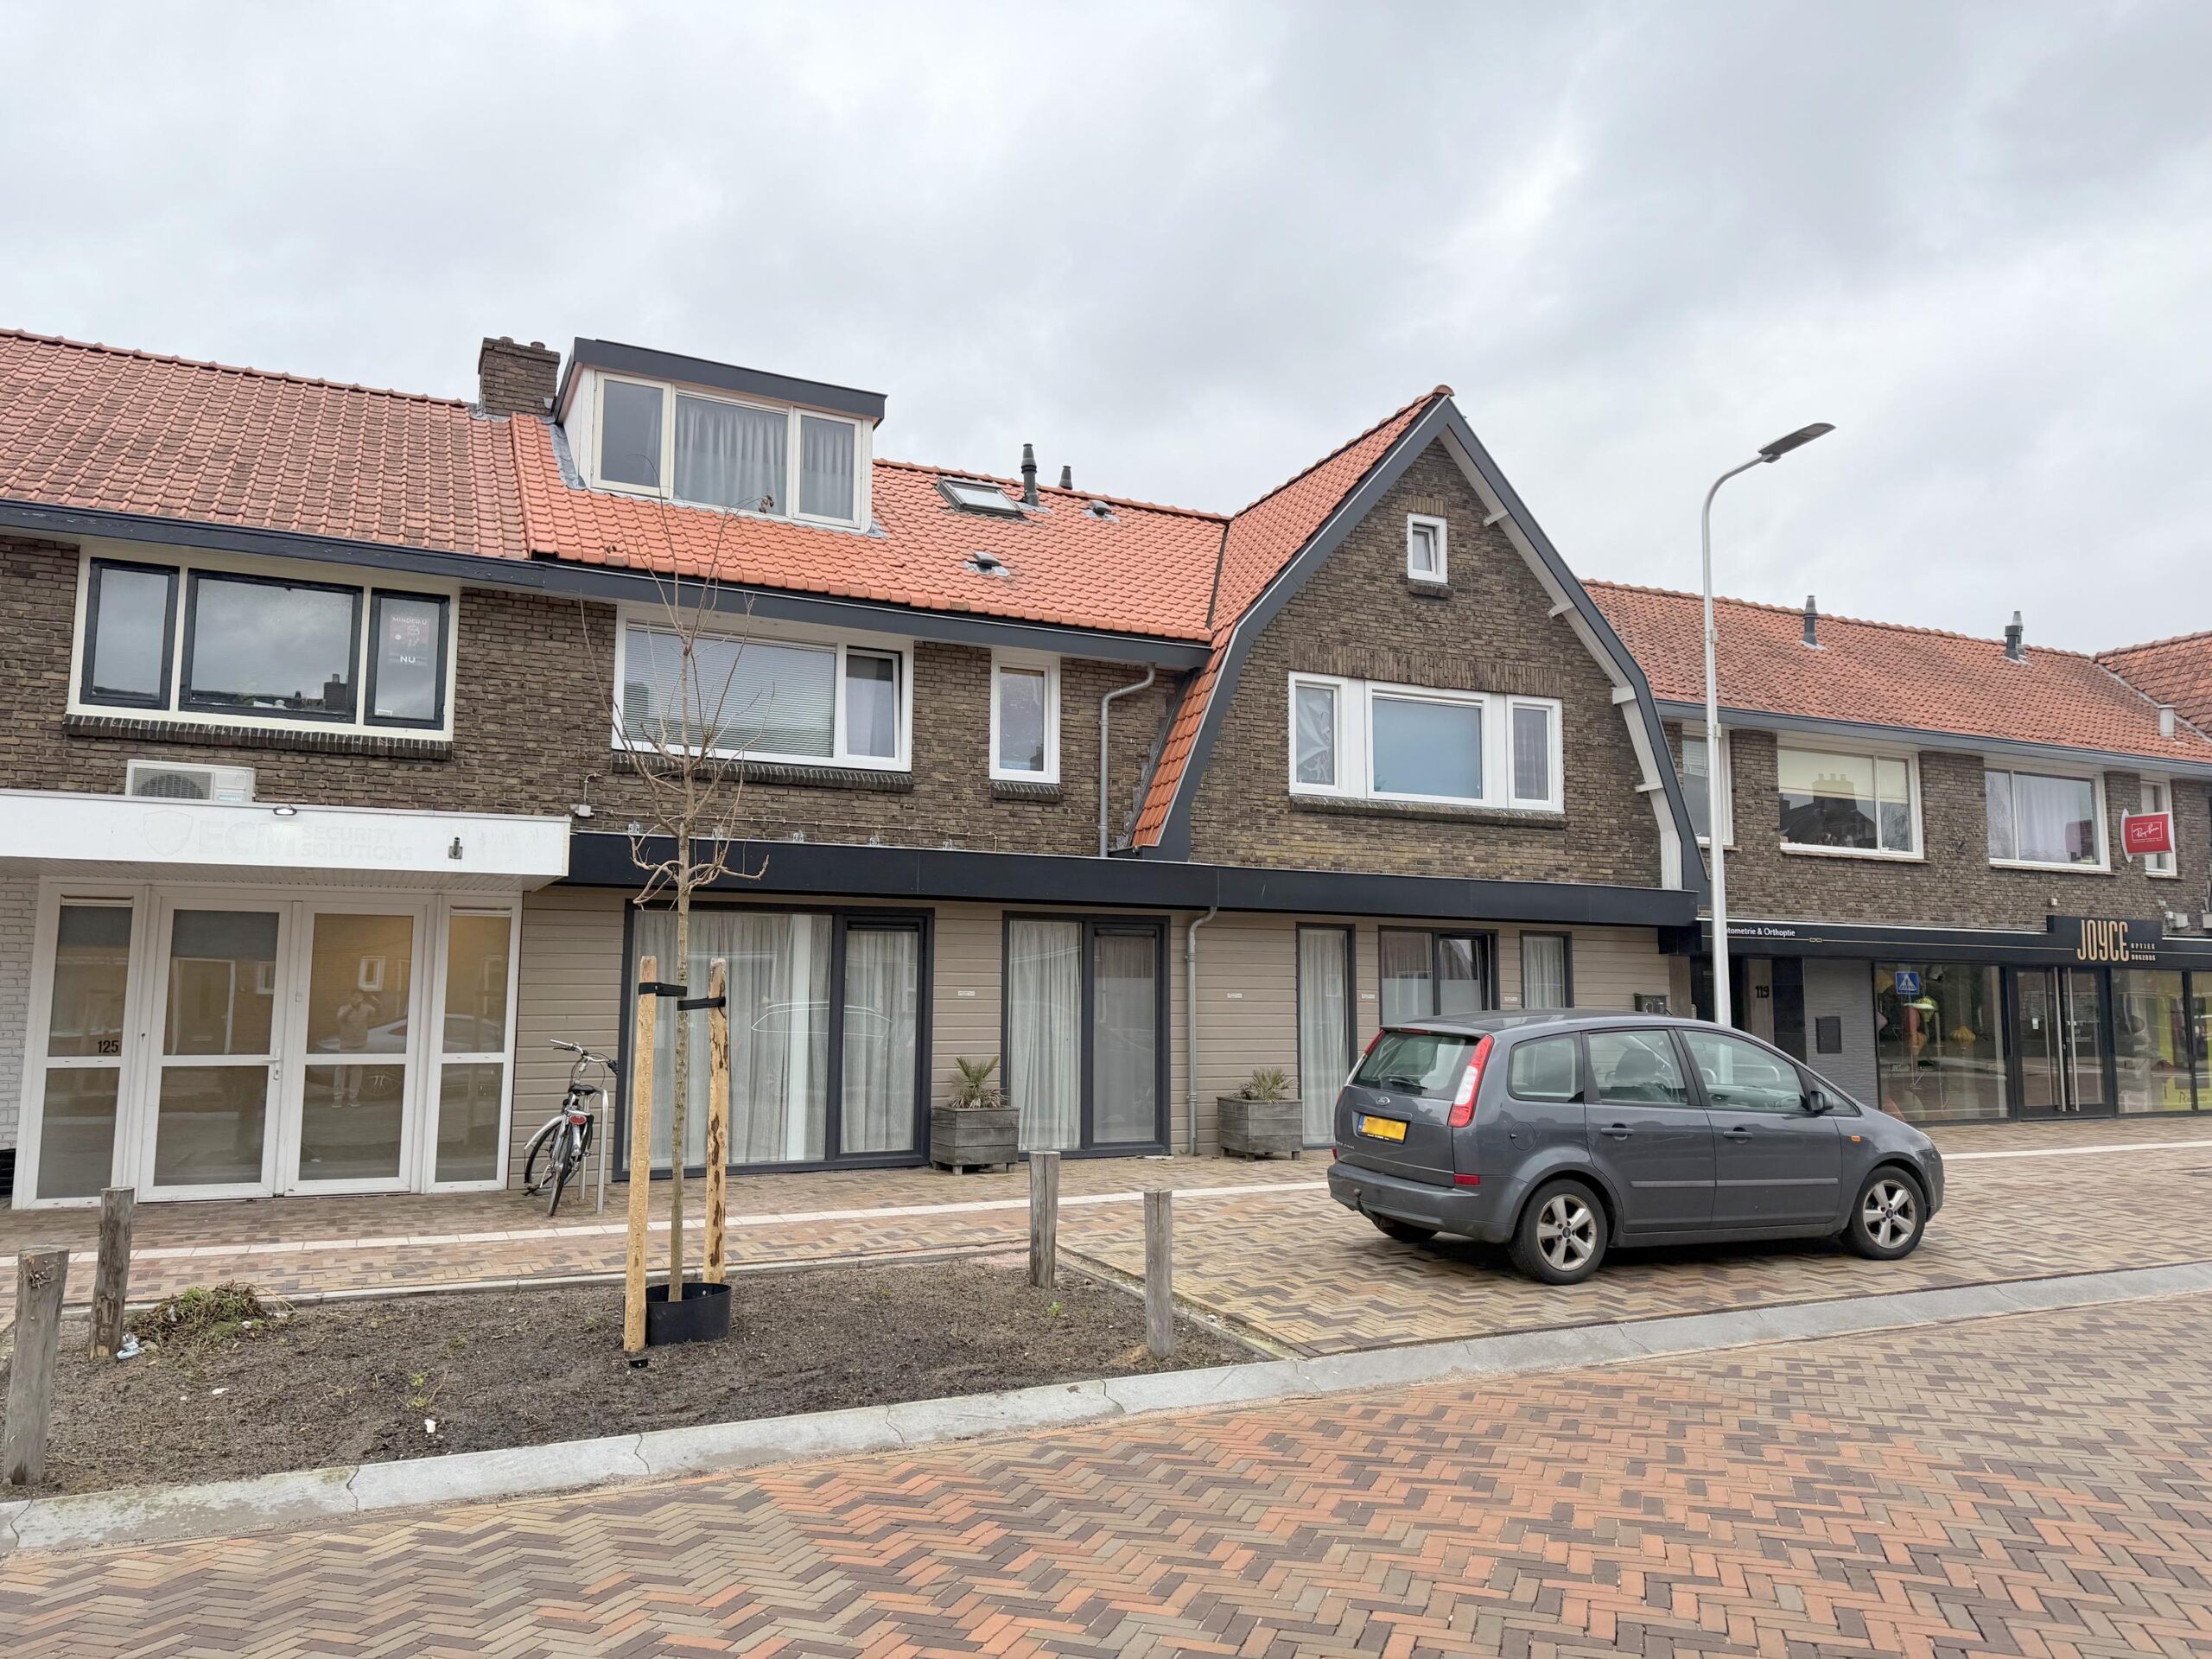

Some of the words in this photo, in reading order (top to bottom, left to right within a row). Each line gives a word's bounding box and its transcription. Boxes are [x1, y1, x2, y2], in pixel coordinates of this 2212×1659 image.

[302, 825, 398, 842] SECURITY
[301, 842, 414, 861] SOLUTIONS
[1726, 926, 1756, 935] tometrie
[1764, 927, 1796, 938] Orthoptie
[2076, 919, 2130, 962] JOYCE
[1755, 985, 1770, 999] 119
[98, 1039, 119, 1053] 125
